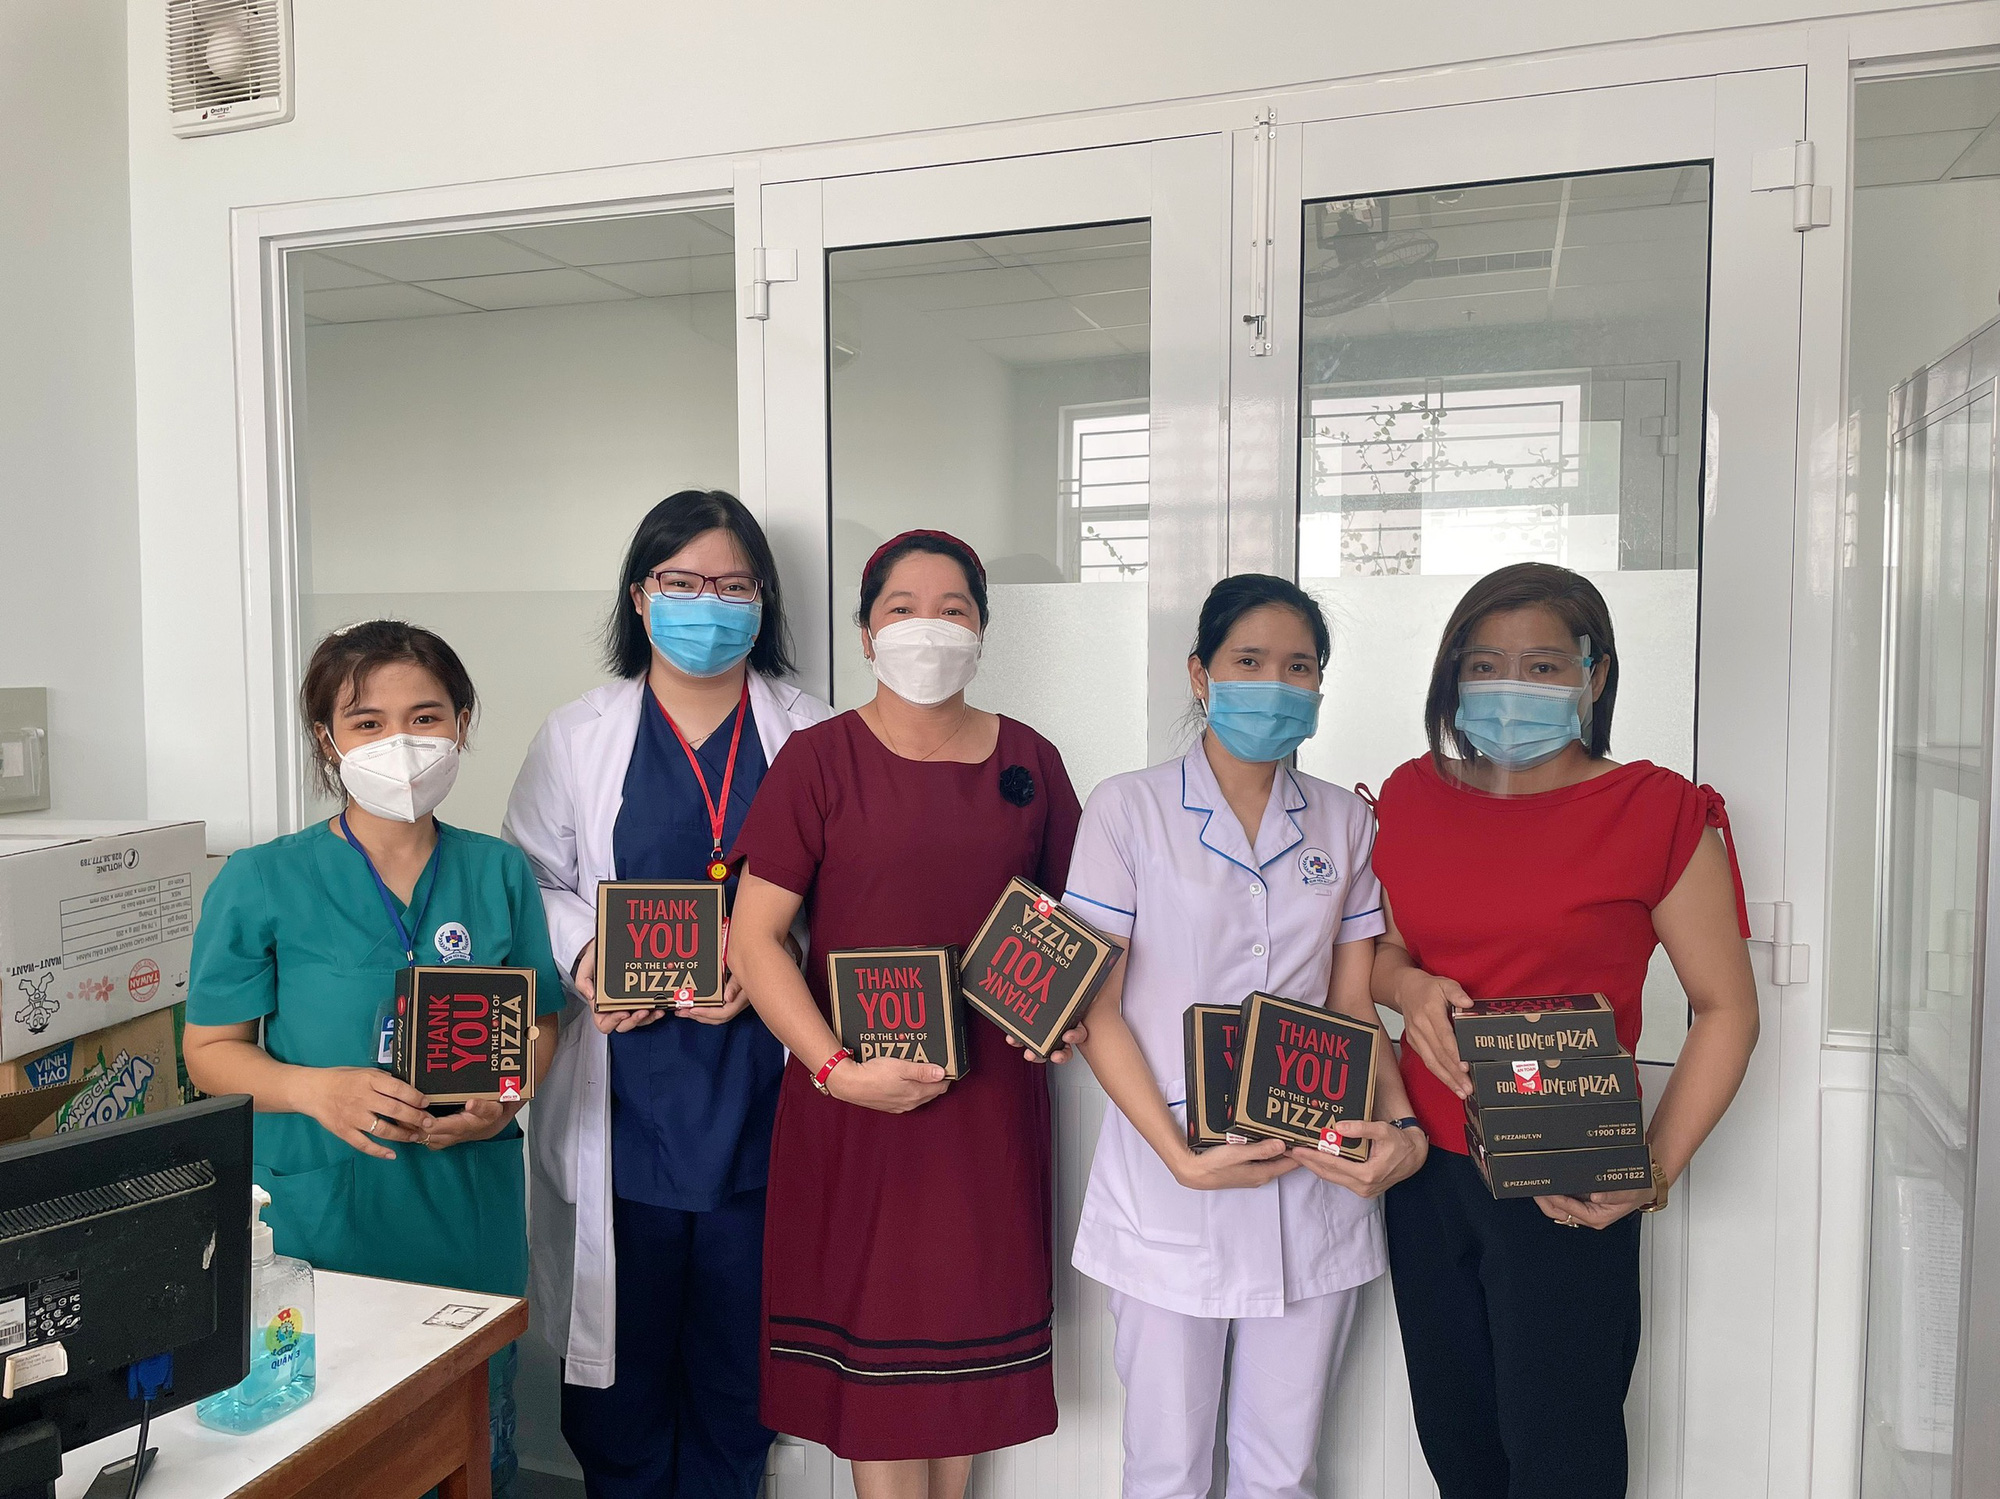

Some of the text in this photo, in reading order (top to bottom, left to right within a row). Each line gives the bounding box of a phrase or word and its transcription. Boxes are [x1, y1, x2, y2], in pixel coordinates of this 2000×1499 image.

[97, 862, 122, 874] HOTLINE
[626, 900, 698, 920] THANK
[626, 923, 699, 959] YOU
[1011, 923, 1071, 969] FOR THE LOVE OF
[1022, 903, 1082, 961] PIZZA
[130, 971, 159, 989] TAIWAN
[624, 971, 698, 992] PIZZA
[625, 961, 699, 970] FOR THE LOVE OF
[854, 967, 923, 990] THANK
[990, 936, 1057, 1004] YOU
[857, 991, 926, 1029] YOU
[978, 967, 1040, 1026] THANK
[427, 994, 450, 1073] THANK
[451, 994, 489, 1072] YOU
[491, 994, 500, 1071] FOR THE LOVE OF
[500, 995, 521, 1071] PIZZA
[860, 1033, 876, 1041] FOR
[894, 1032, 914, 1040] LOVE
[917, 1032, 928, 1040] OF
[1278, 1019, 1351, 1061] THANK
[1475, 1028, 1599, 1051] FOR THE LOVE OF PIZZA
[860, 1042, 930, 1063] PIZZA
[1275, 1044, 1349, 1101] YOU
[1496, 1081, 1517, 1093] FOR
[1567, 1080, 1577, 1092] OF
[1578, 1073, 1620, 1097] PIZZA
[1266, 1096, 1336, 1132] PIZZA
[1268, 1086, 1344, 1114] FOR THE LOVE OF
[1603, 1171, 1645, 1181] 1900 1822
[295, 1350, 300, 1358] 3
